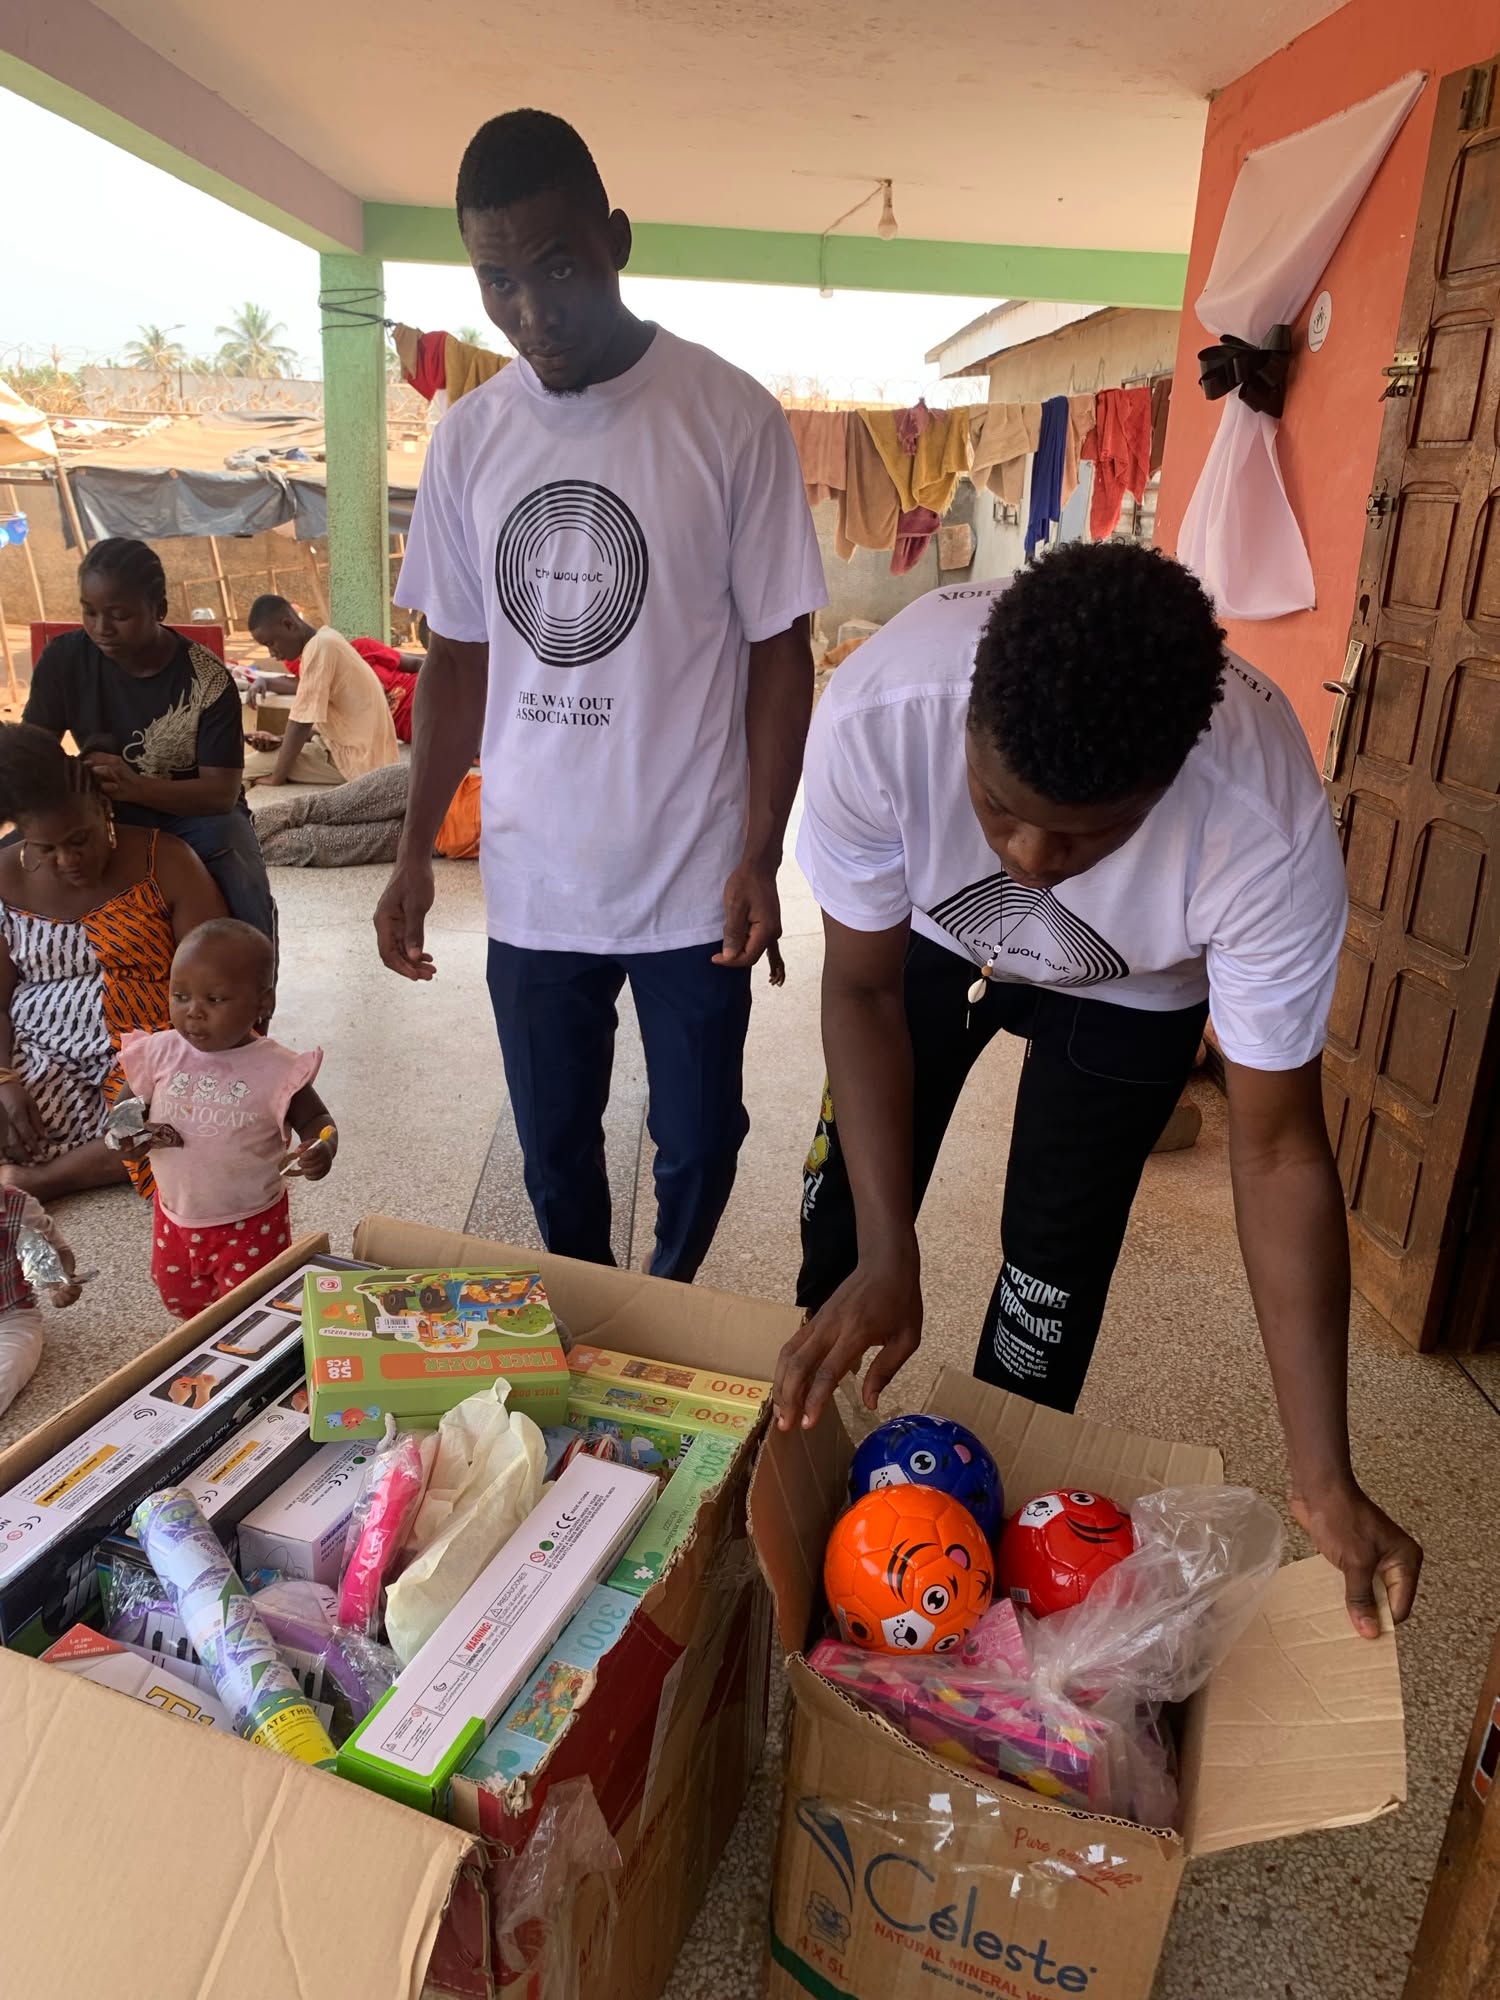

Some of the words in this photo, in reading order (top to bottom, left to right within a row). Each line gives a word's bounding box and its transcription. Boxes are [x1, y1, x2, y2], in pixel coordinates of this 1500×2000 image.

[553, 570, 579, 583] way
[581, 571, 604, 583] out
[938, 588, 998, 603] HOIX
[1229, 663, 1273, 703] L'ED
[518, 690, 538, 707] THE
[542, 694, 575, 710] WAY
[578, 696, 614, 711] OUT
[515, 707, 611, 727] ASSOCIATION
[973, 938, 995, 953] th
[1007, 946, 1041, 961] way
[1044, 958, 1071, 974] out
[326, 1358, 351, 1367] PCS
[424, 1354, 493, 1373] DOZER
[497, 1350, 558, 1369] TRICK
[328, 1366, 352, 1379] 58
[711, 1380, 763, 1399] 300
[694, 1408, 749, 1428] 300
[168, 1463, 181, 1475] TO
[153, 1471, 171, 1488] YOU
[125, 1484, 154, 1512] WORLD
[107, 1508, 127, 1527] CUP
[577, 1603, 627, 1650] 300
[464, 1621, 492, 1653] WARNING:
[254, 1713, 288, 1745] OTATE
[290, 1706, 313, 1718] THIS
[1014, 1826, 1051, 1853] Pure
[863, 1852, 1091, 1993] Céleste
[874, 1921, 945, 1964] NATURAL
[949, 1956, 1022, 1999] MINERAL
